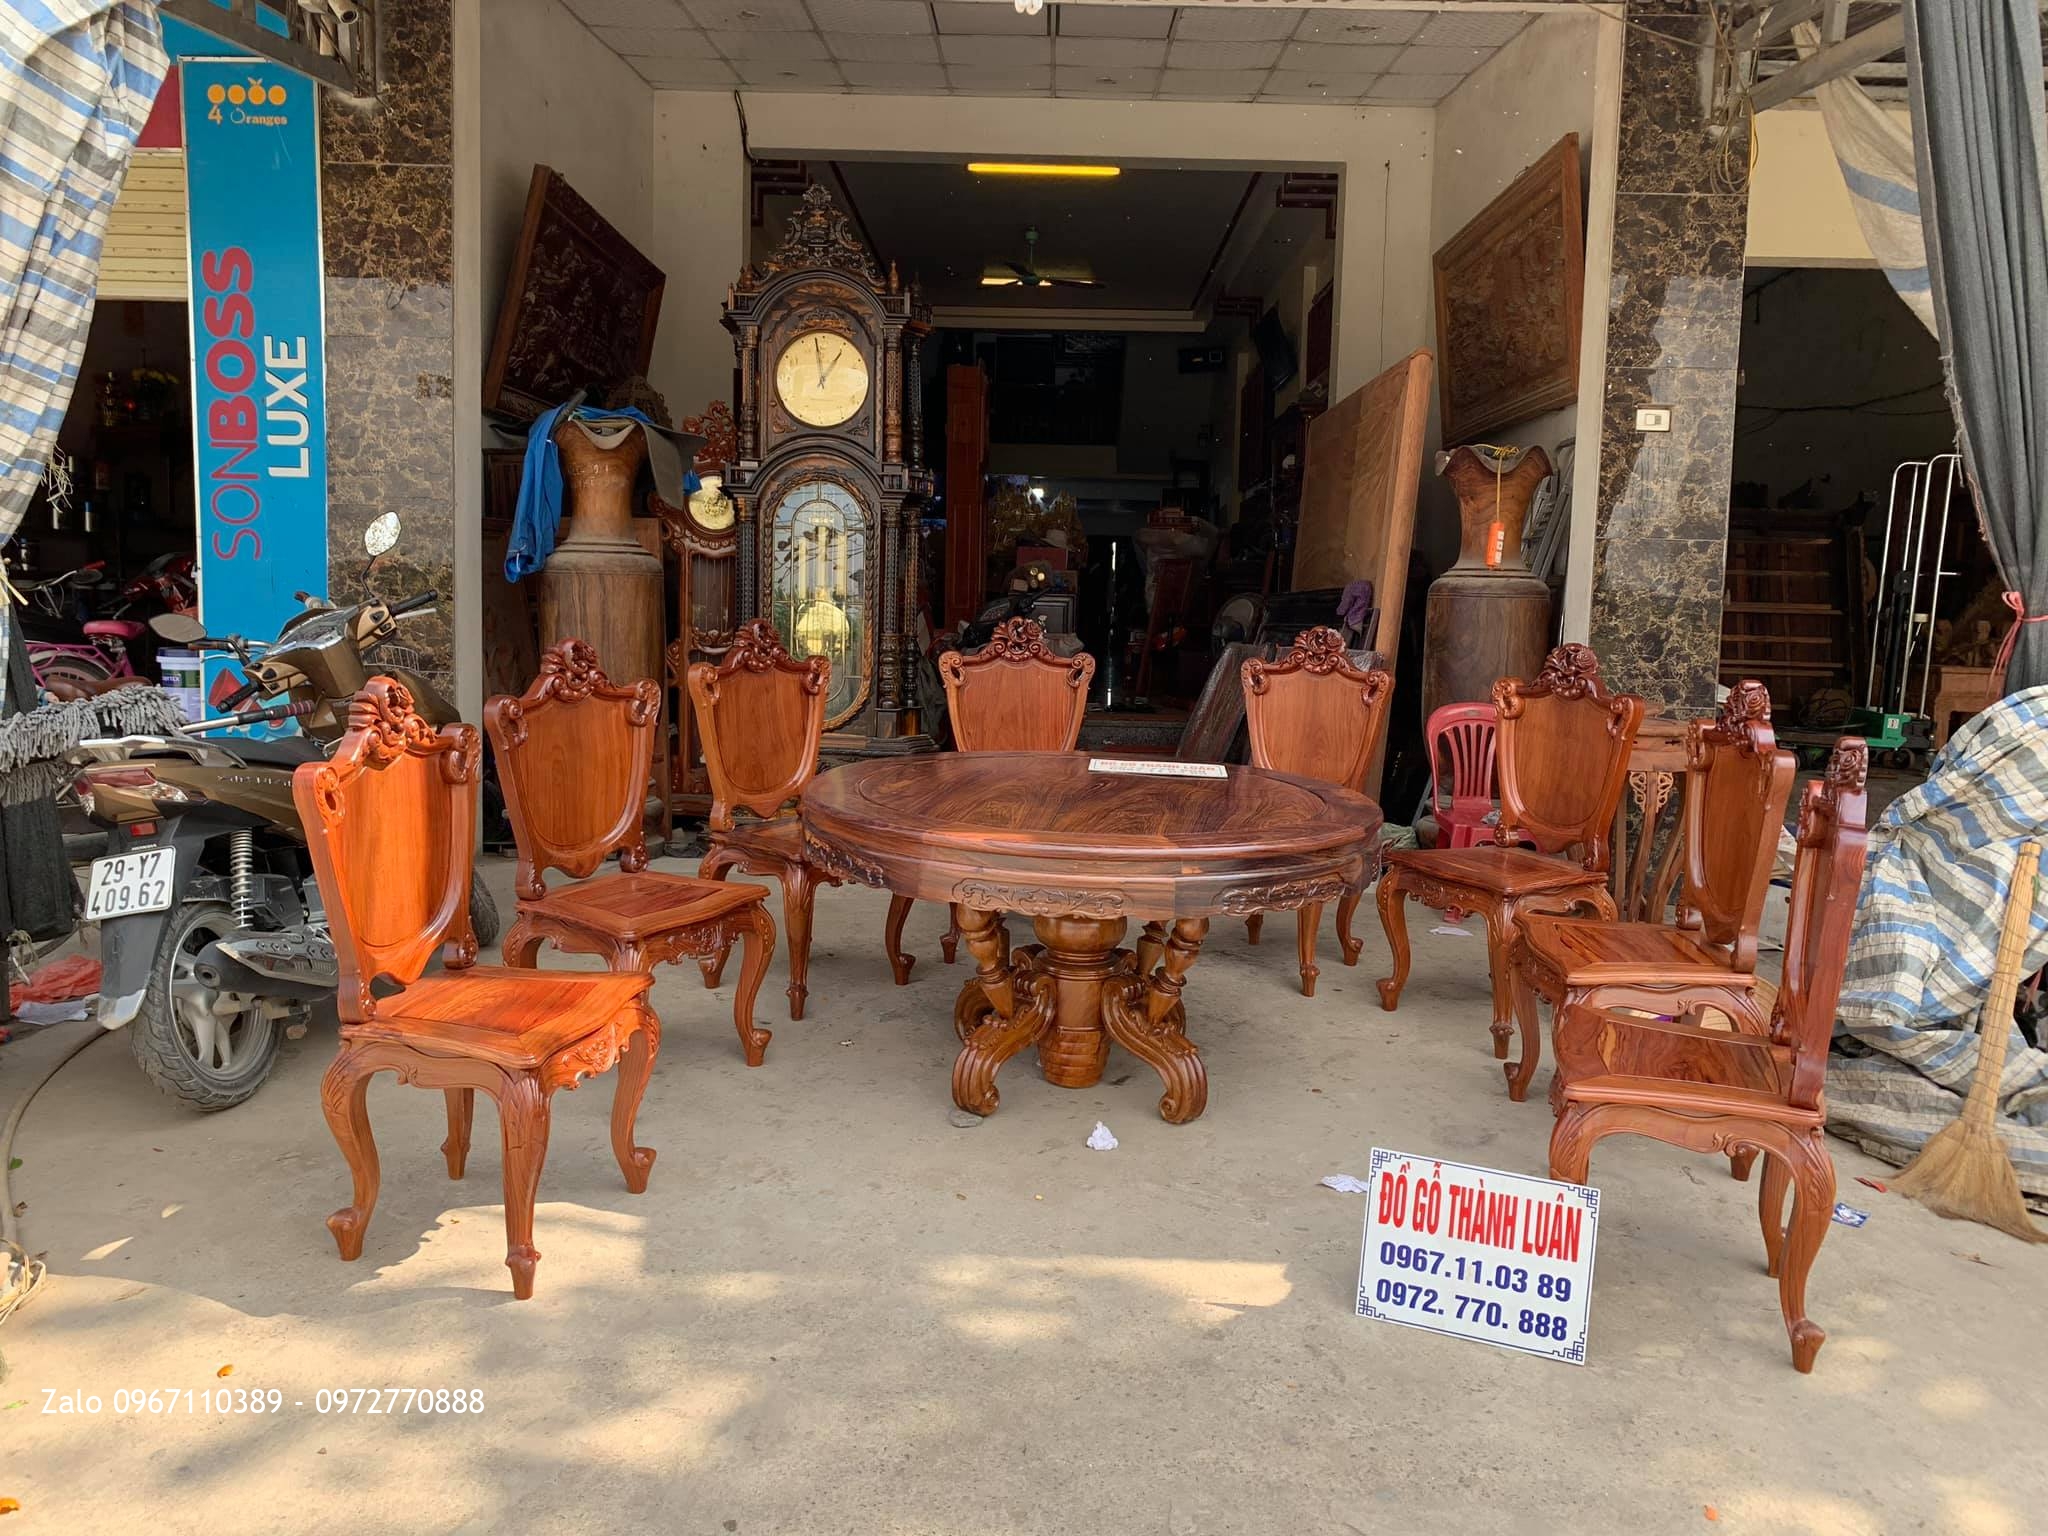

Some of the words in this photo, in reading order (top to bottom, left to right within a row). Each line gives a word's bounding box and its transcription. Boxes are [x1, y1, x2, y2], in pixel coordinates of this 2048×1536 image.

[208, 104, 222, 125] 4
[231, 107, 287, 126] Oranges
[202, 247, 262, 560] SONBOSS
[263, 335, 310, 478] LUXE
[91, 880, 165, 915] 409.62
[101, 852, 161, 886] 29-Y7
[1378, 1161, 1410, 1228] ĐỒ
[1412, 1162, 1442, 1235] GỖ
[1448, 1179, 1518, 1250] THÀNH
[1522, 1192, 1582, 1263] LUÂN
[1380, 1241, 1528, 1293] 0967.11.03
[1537, 1273, 1572, 1302] 89
[1376, 1278, 1444, 1316] 0972.
[1455, 1294, 1508, 1329] 770.
[1518, 1309, 1568, 1341] 888
